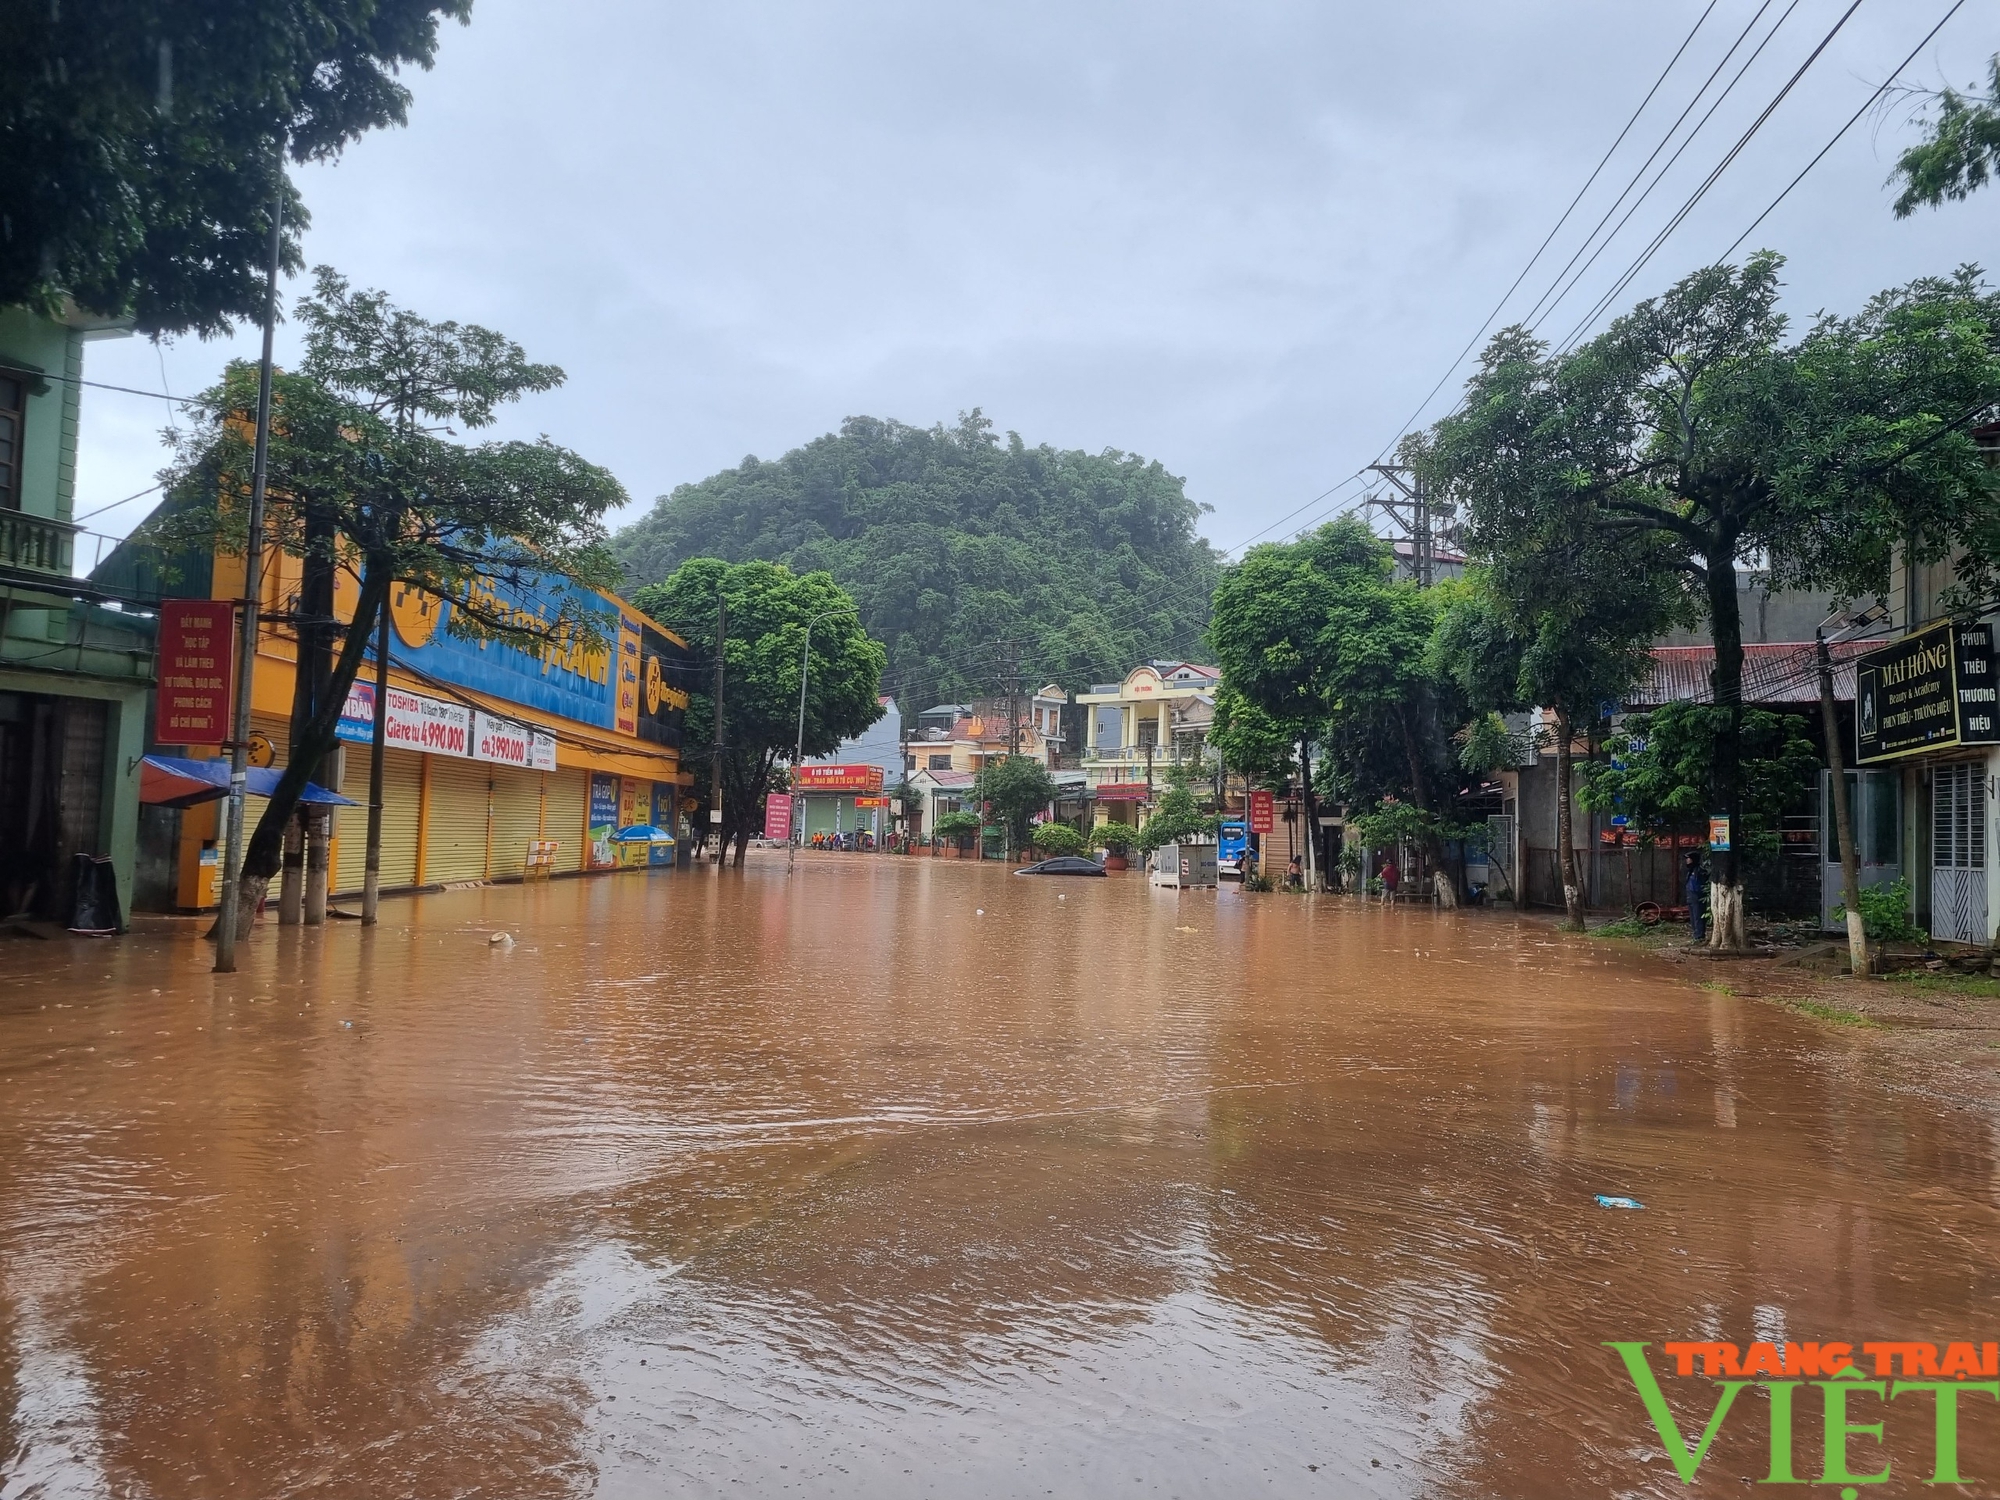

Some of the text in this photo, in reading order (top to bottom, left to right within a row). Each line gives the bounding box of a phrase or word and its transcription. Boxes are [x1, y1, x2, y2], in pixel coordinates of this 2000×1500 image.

[1961, 632, 1986, 647] PHUN
[199, 657, 214, 669] THEO
[1882, 640, 1947, 688] MAI HỒNG
[1964, 658, 1987, 674] THÊU
[1889, 680, 1941, 705] Beauty & Academy
[1959, 688, 1996, 703] THƯƠNG
[173, 695, 212, 709] PHONG CÁCH
[387, 692, 419, 714] TOSHIBA
[1914, 704, 1937, 721] THƯƠNG
[1937, 697, 1951, 717] HIỆU
[180, 715, 190, 728] CHÍ
[1969, 715, 1991, 733] HIỆU
[386, 716, 401, 739] Giá
[421, 720, 465, 753] 4.990.000
[491, 734, 525, 763] 3.990.000
